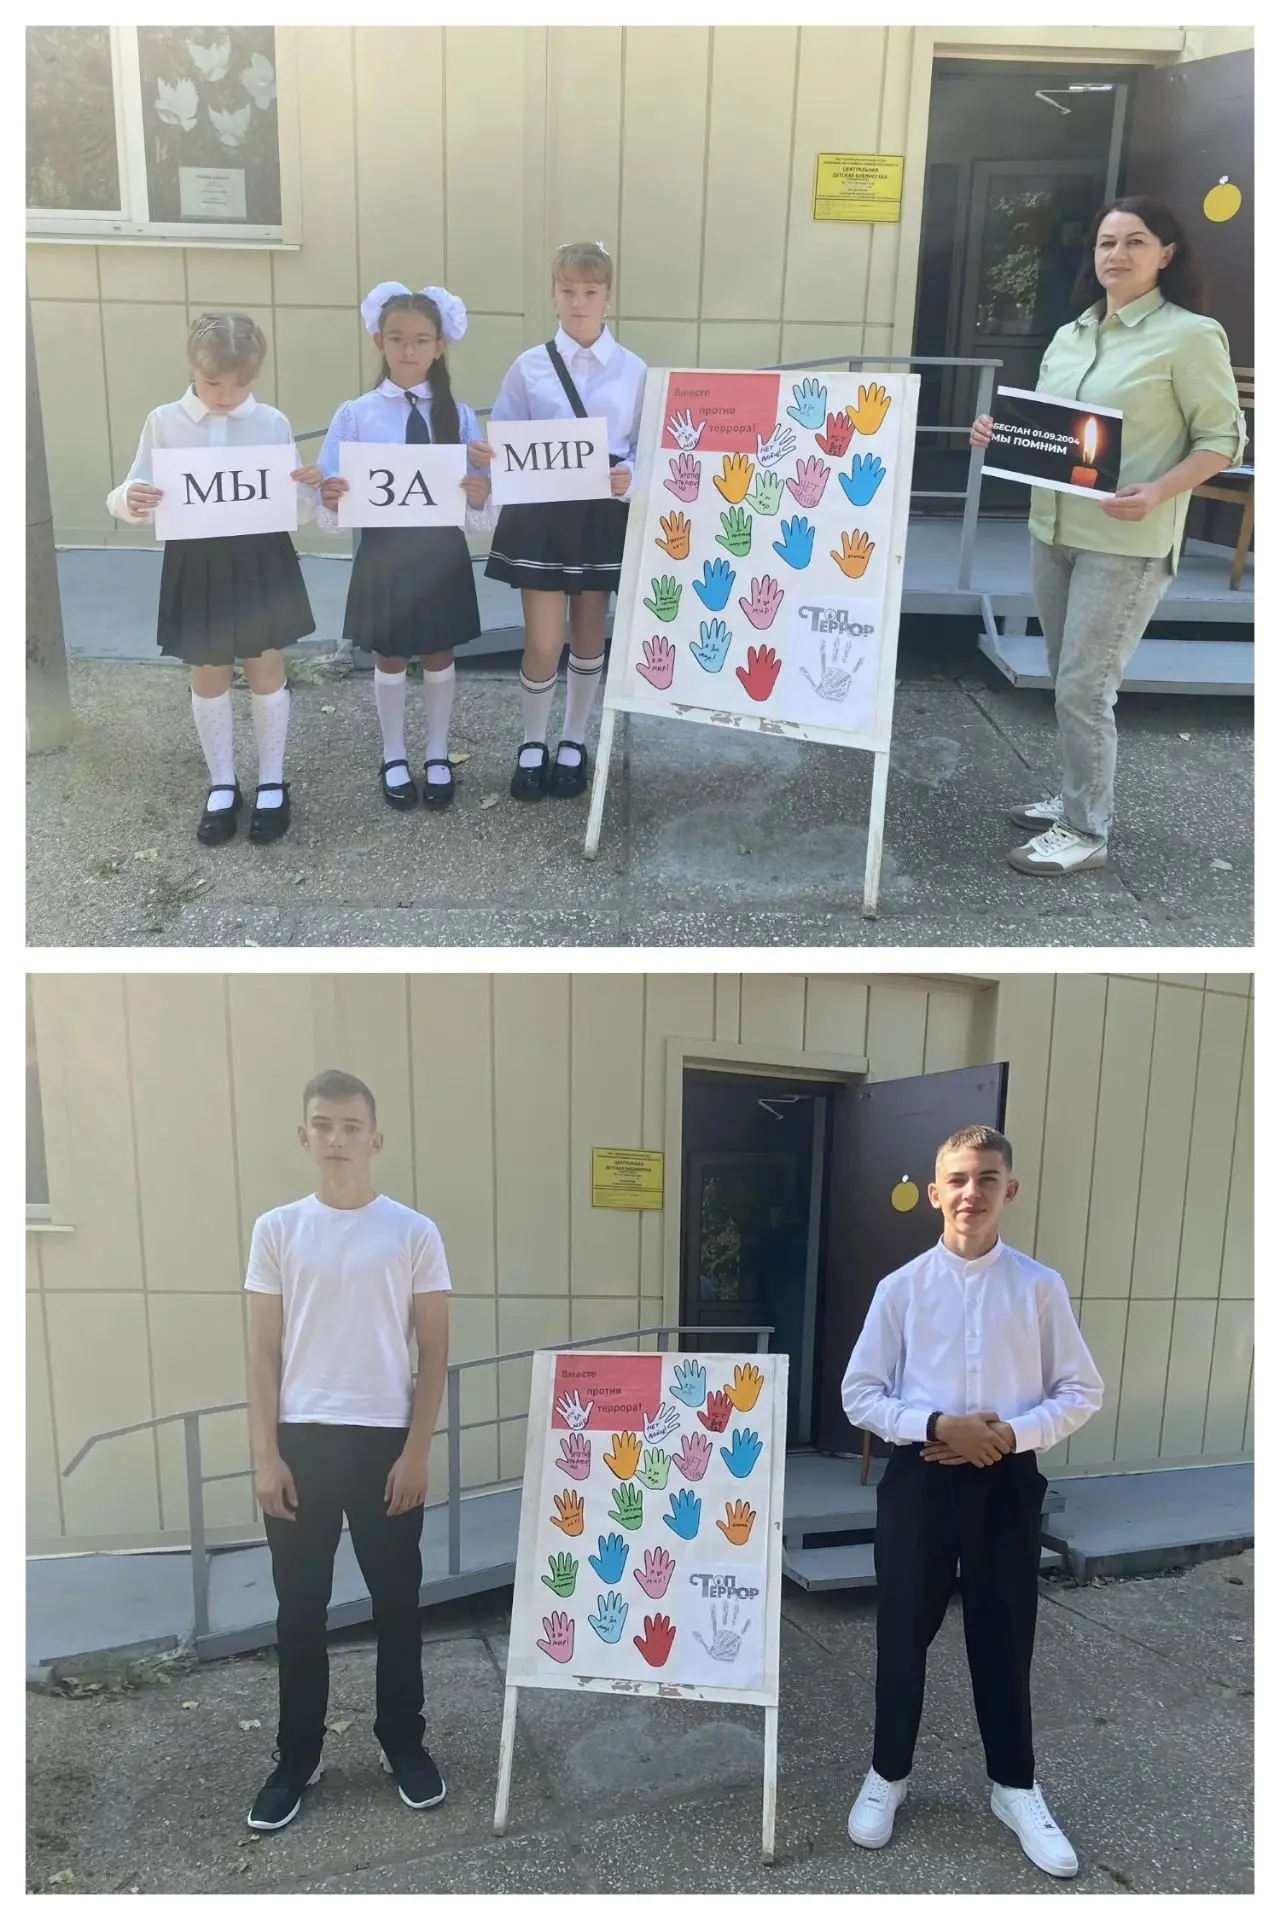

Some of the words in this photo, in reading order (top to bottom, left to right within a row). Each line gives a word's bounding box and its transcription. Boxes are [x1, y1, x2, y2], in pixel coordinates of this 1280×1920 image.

[673, 387, 711, 397] Вместе
[699, 406, 736, 417] против
[709, 423, 756, 434] террора!
[993, 421, 1031, 436] БЕСЛАН
[1032, 428, 1080, 445] 01.09.2004
[991, 433, 1011, 444] МЫ
[1013, 437, 1067, 455] ПОМНИМ
[503, 440, 594, 472] МИР
[181, 468, 271, 505] МЫ
[368, 468, 438, 507] ЗА
[561, 1369, 597, 1379] Вместе
[586, 1387, 622, 1397] против
[597, 1402, 642, 1413] террора!
